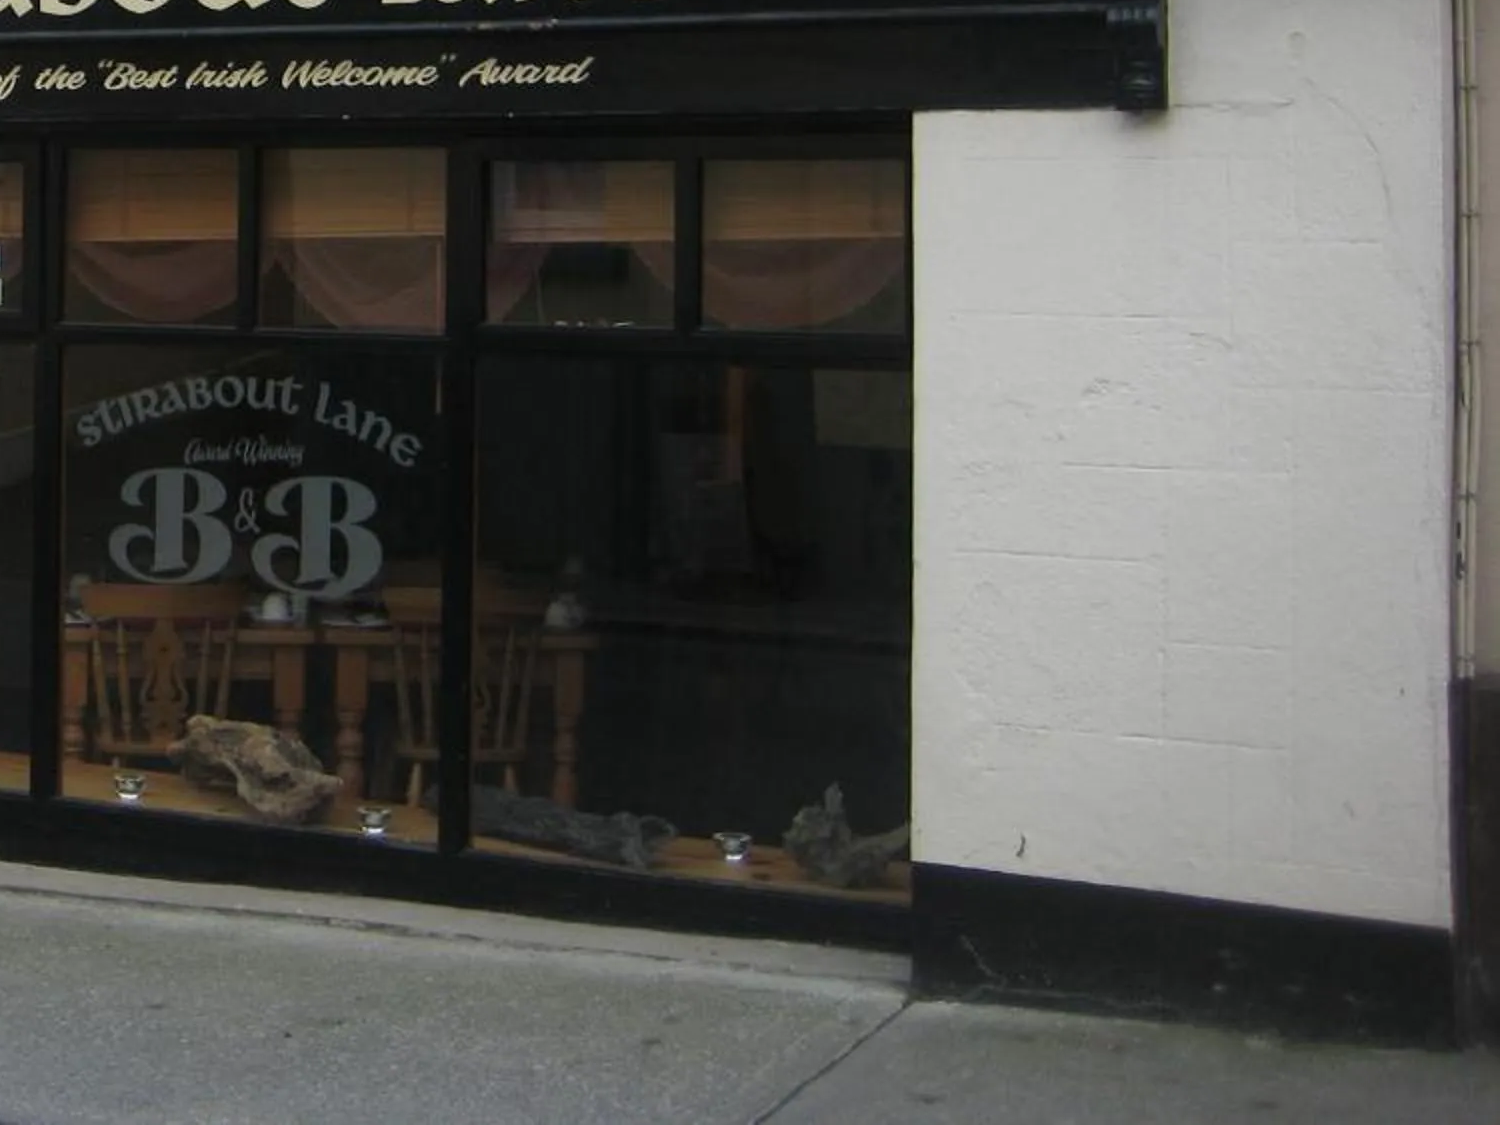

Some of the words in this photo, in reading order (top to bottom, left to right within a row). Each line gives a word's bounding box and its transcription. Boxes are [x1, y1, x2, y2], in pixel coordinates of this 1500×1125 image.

[35, 64, 86, 90] the
[185, 59, 267, 90] Irish
[459, 57, 593, 87] Award
